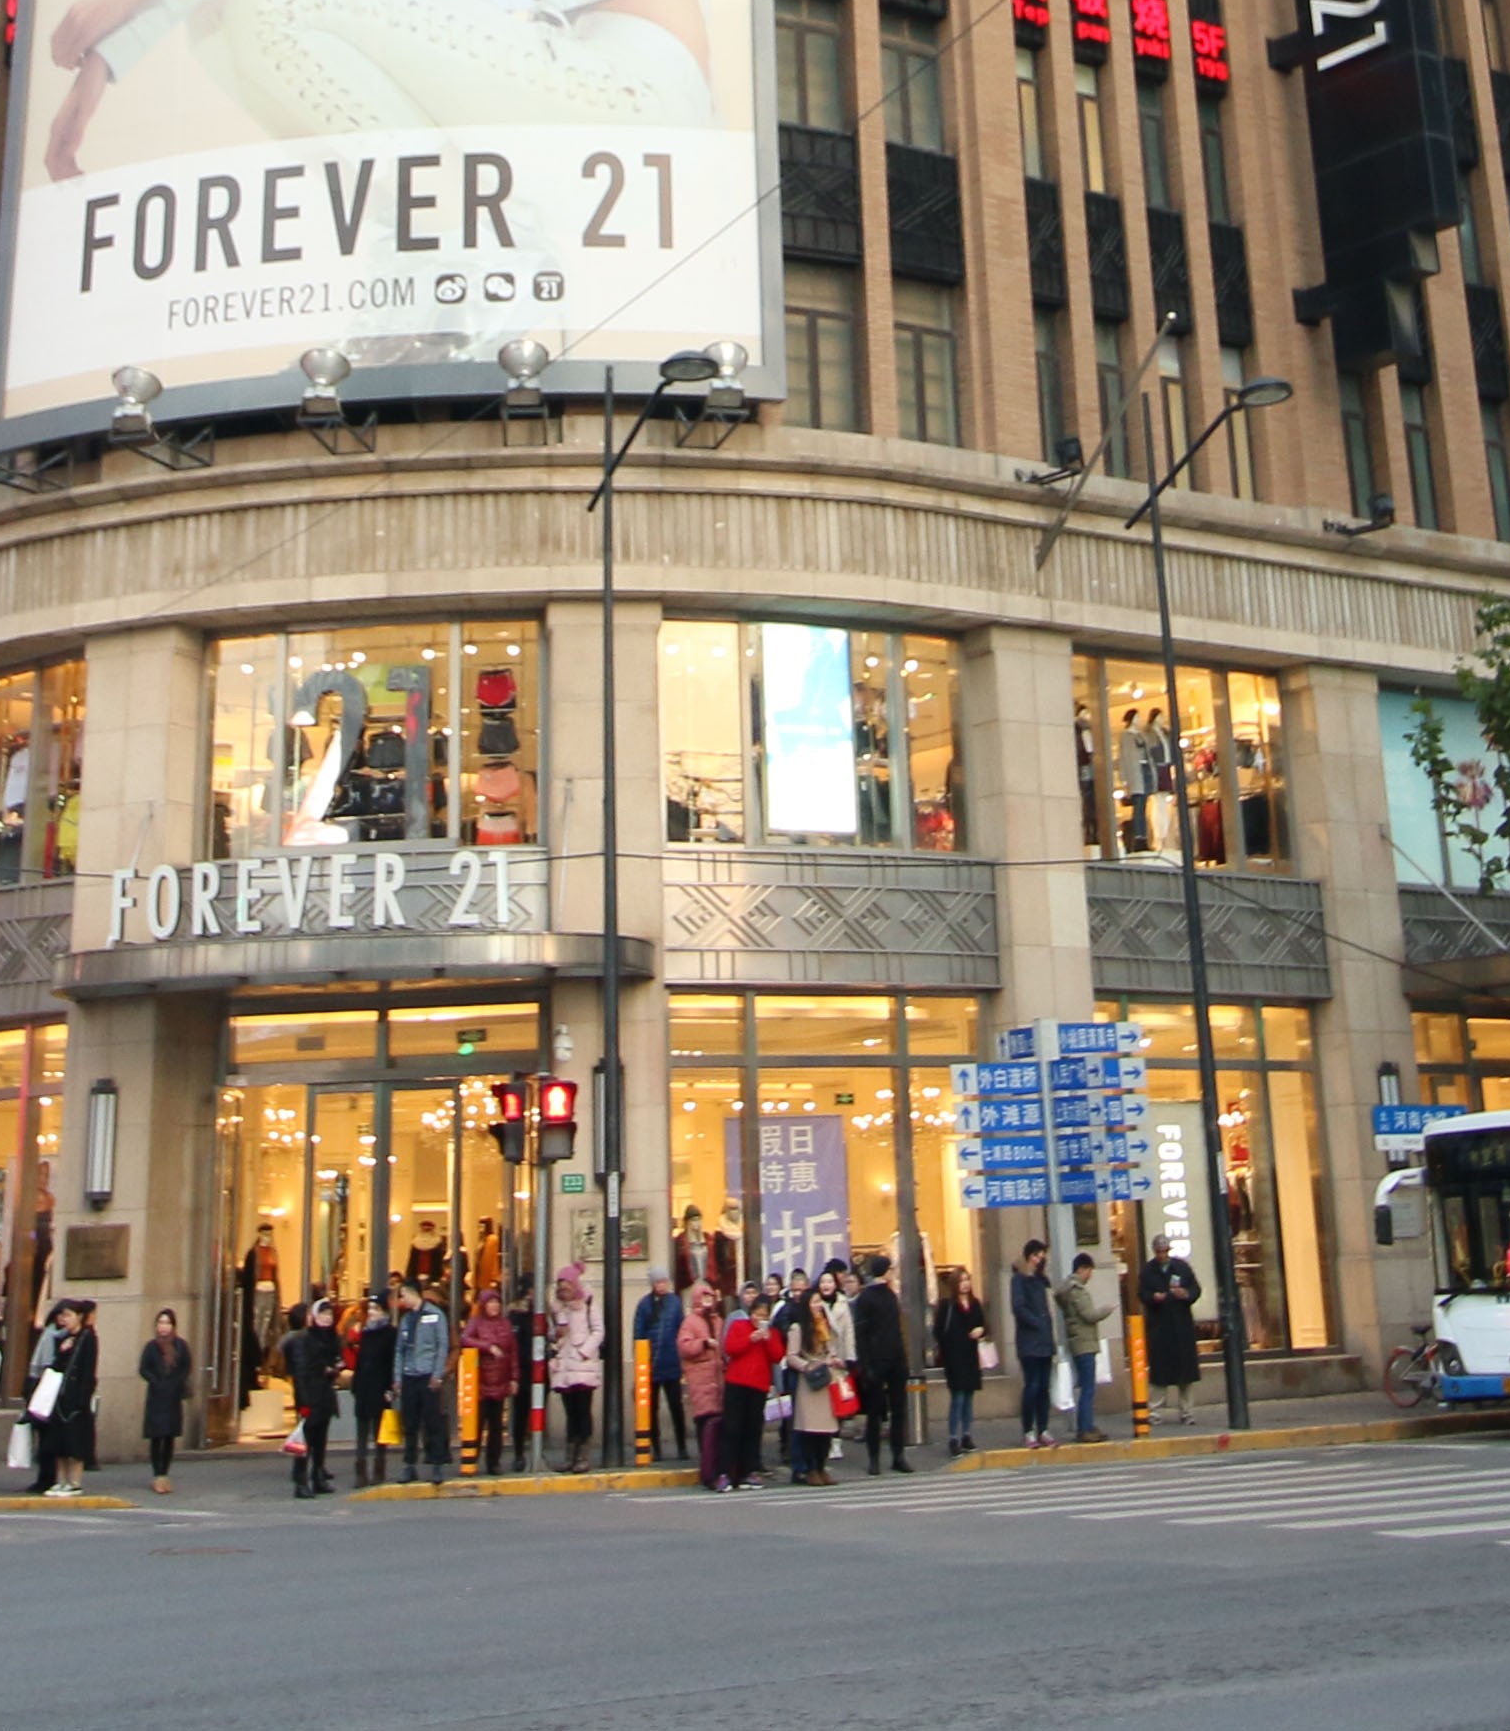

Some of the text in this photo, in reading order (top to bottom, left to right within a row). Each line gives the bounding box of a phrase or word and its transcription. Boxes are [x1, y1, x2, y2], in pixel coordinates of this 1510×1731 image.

[1191, 20, 1226, 58] 5F
[79, 152, 674, 293] FOREVER 21
[167, 277, 416, 330] FOREVER21.COM
[107, 850, 512, 948] FOREVER 21
[978, 1066, 1037, 1089] 外白渡桥
[1156, 1124, 1192, 1259] FOREVER
